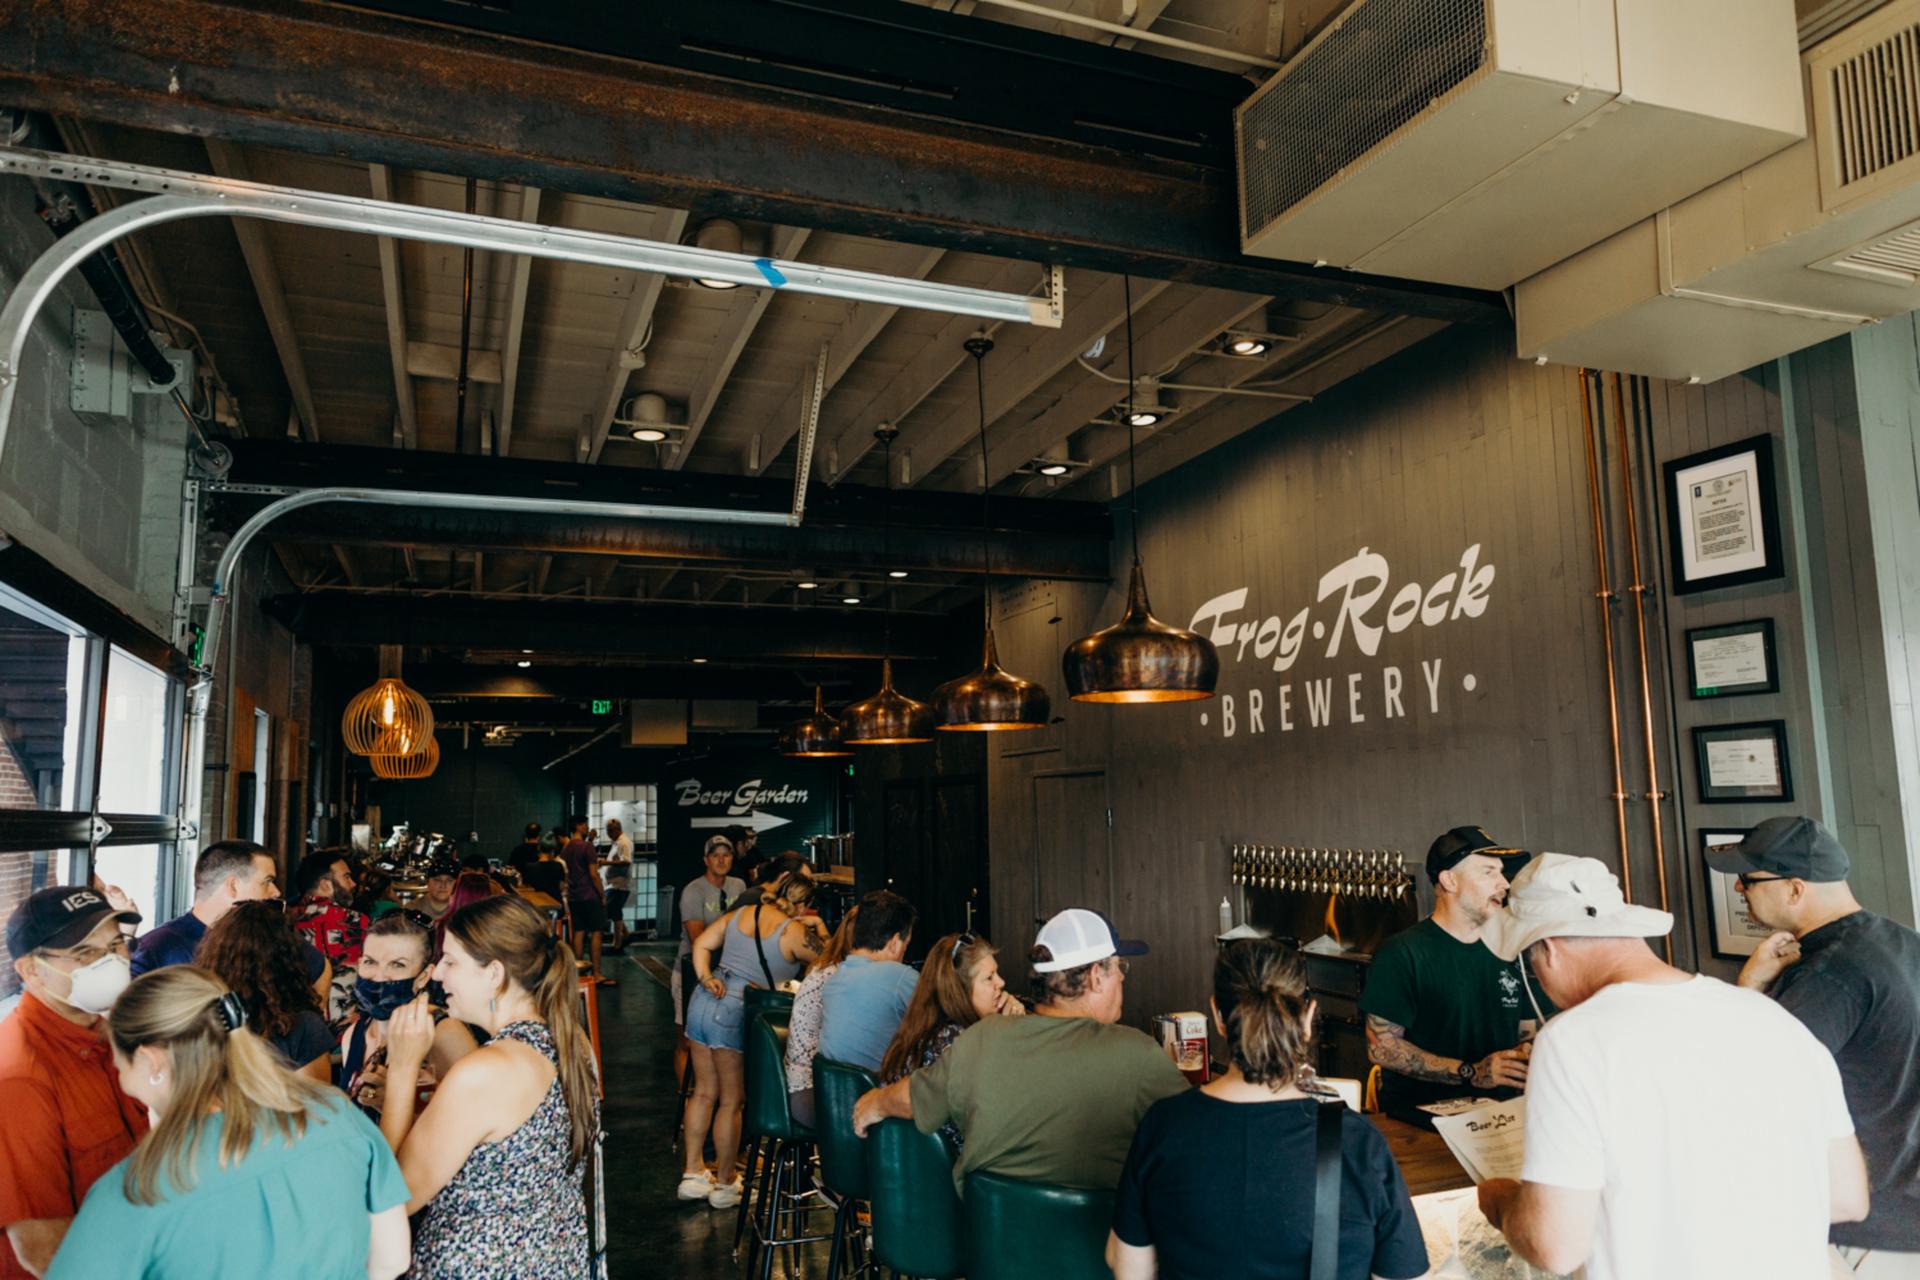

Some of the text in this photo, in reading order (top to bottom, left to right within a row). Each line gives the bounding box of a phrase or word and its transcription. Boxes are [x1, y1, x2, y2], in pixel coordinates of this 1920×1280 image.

[1221, 658, 1443, 739] BREWERY
[674, 777, 809, 815] Beer Garden
[62, 891, 102, 912] IES
